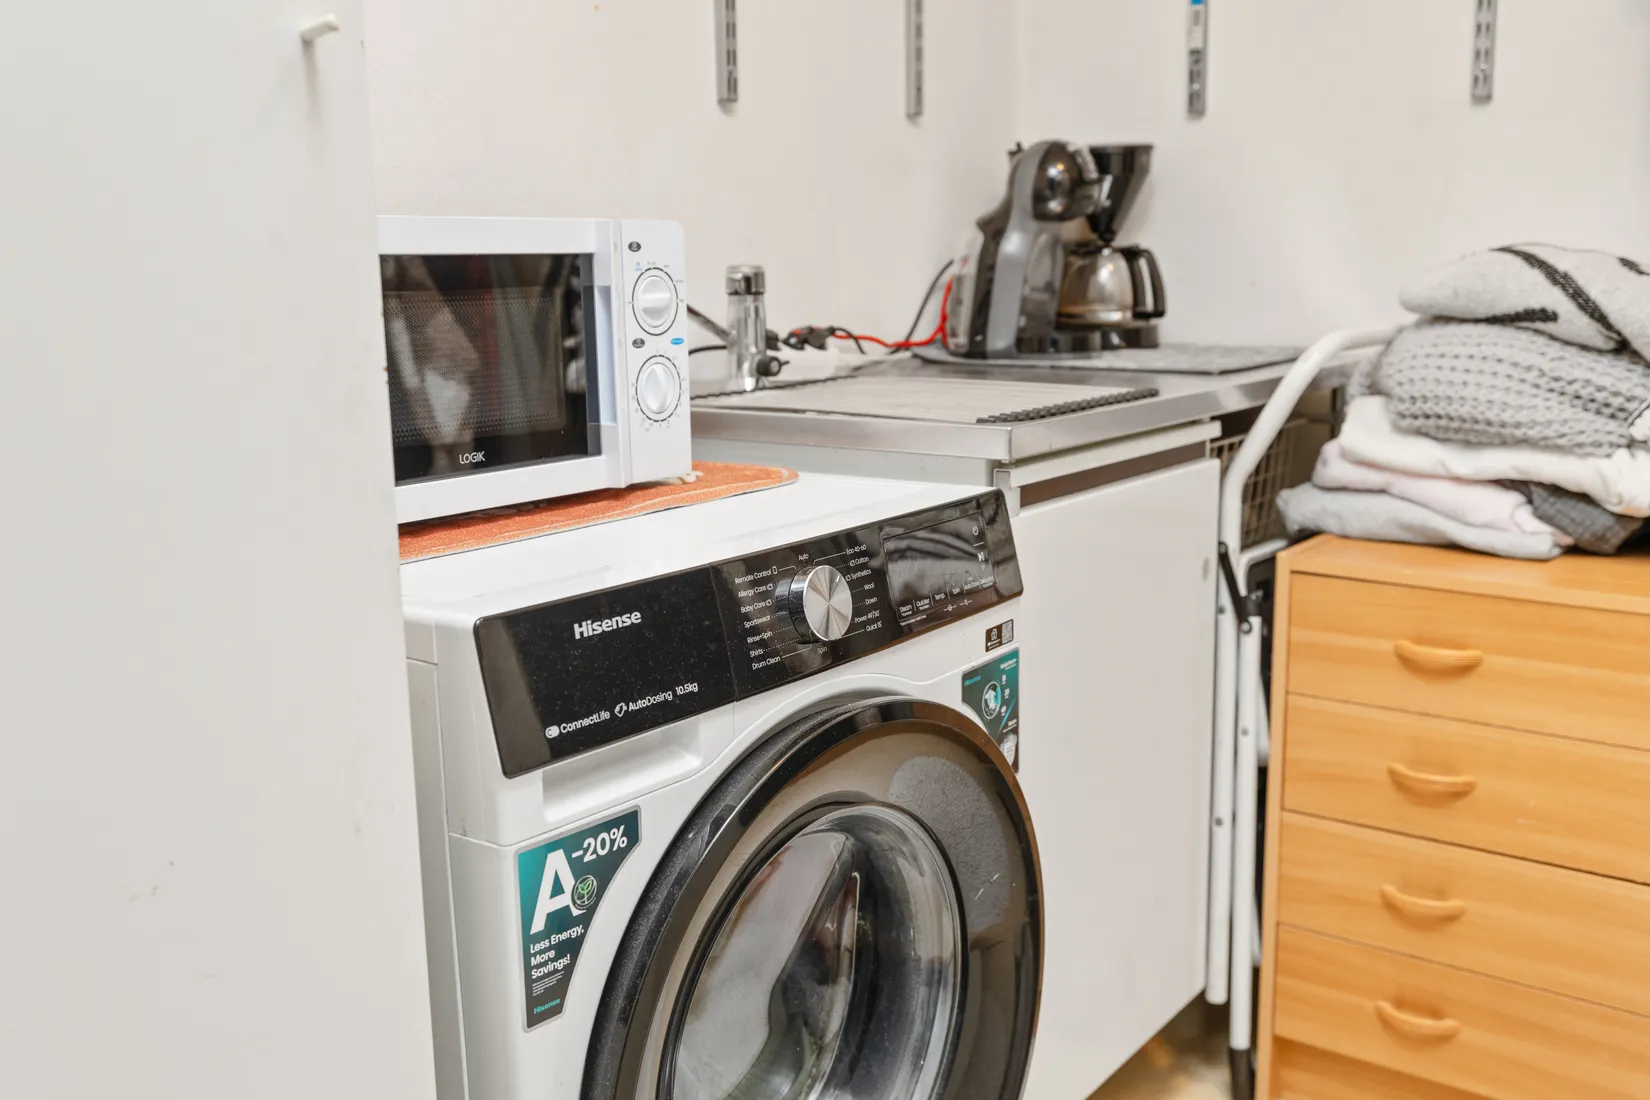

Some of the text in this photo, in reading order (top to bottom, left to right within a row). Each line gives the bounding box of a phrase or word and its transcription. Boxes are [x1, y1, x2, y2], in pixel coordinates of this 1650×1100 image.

[459, 451, 485, 464] LOGIK
[735, 569, 771, 584] Remote Control
[851, 569, 871, 579] Synthetics
[738, 587, 754, 598] Allergy
[864, 582, 875, 590] Wool
[741, 601, 765, 613] Baby Care
[865, 597, 878, 605] Down
[573, 611, 642, 639] Hisense
[744, 615, 771, 629] Sportswear
[866, 623, 877, 631] Quick
[750, 649, 763, 658] Shirts
[752, 656, 780, 670] Drum Clean
[628, 682, 698, 712] AutoDosing 10.5kg
[560, 710, 611, 733] ConnectLife
[530, 848, 587, 935] A
[571, 825, 628, 863] -20%
[530, 924, 585, 954] Less Energy,
[531, 949, 556, 967] More
[531, 953, 571, 979] Savings!
[533, 998, 561, 1015] Hisense
